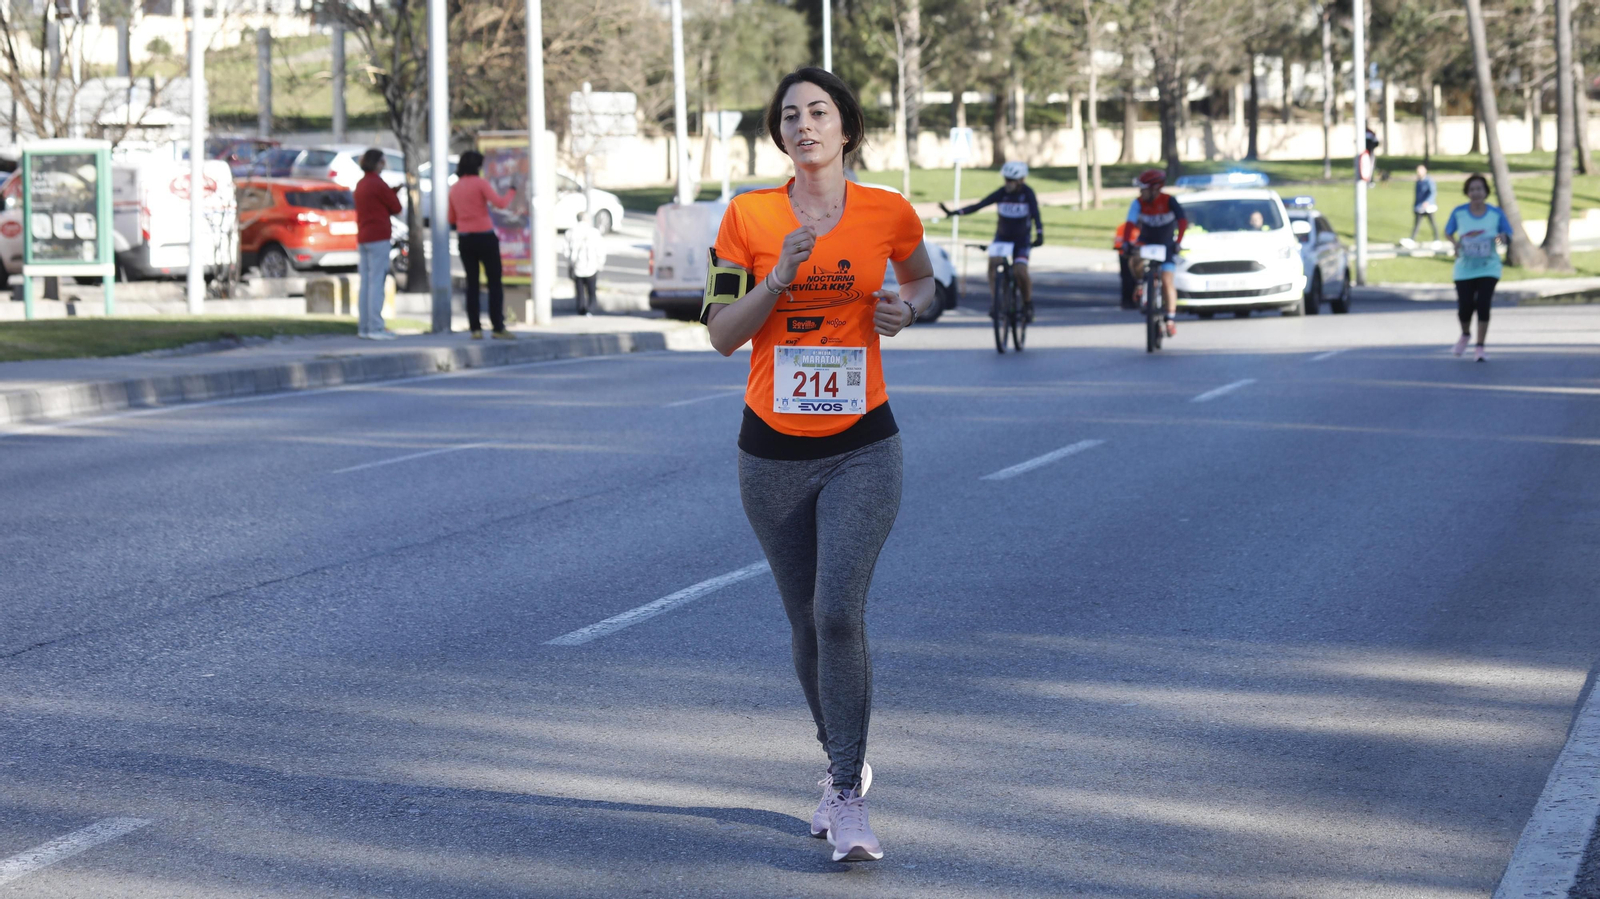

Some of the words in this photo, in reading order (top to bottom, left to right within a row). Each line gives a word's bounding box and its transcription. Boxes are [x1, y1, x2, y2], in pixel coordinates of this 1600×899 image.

[802, 355, 840, 363] MARATÓN
[792, 371, 839, 398] 214
[798, 402, 843, 412] EVOS
